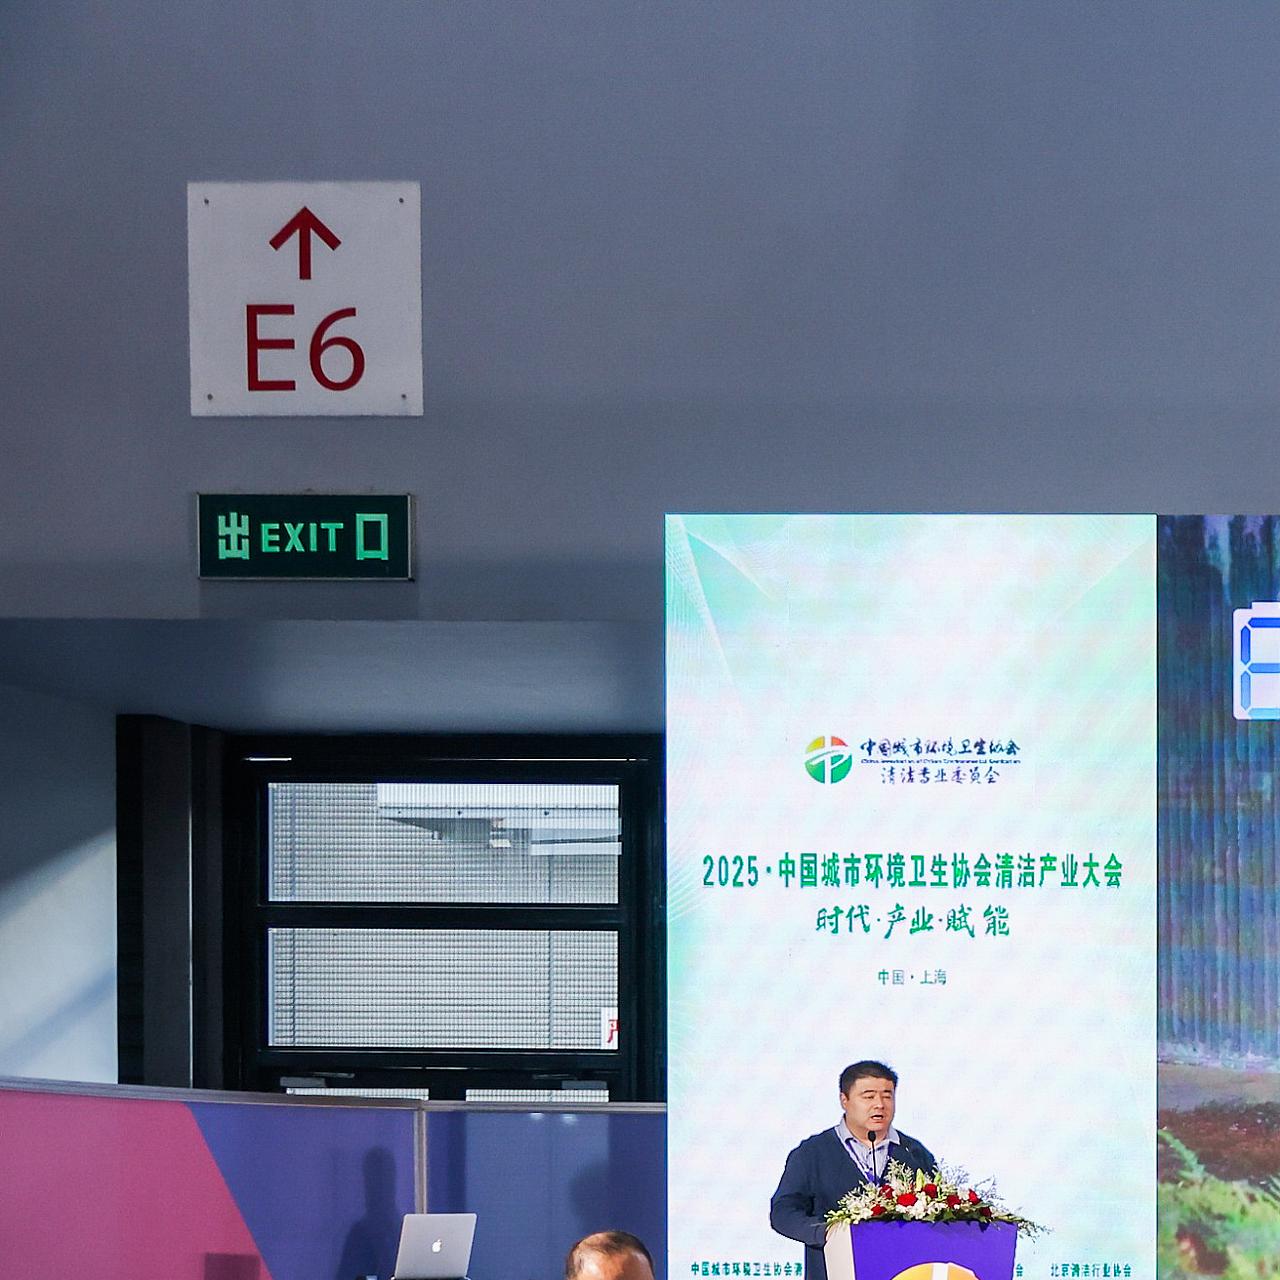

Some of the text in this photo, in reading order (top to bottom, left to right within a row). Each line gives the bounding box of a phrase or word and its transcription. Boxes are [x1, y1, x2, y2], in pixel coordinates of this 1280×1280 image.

[246, 304, 365, 391] E6
[218, 512, 388, 561] 出 EXIT 口
[877, 968, 947, 986] 中国·上海
